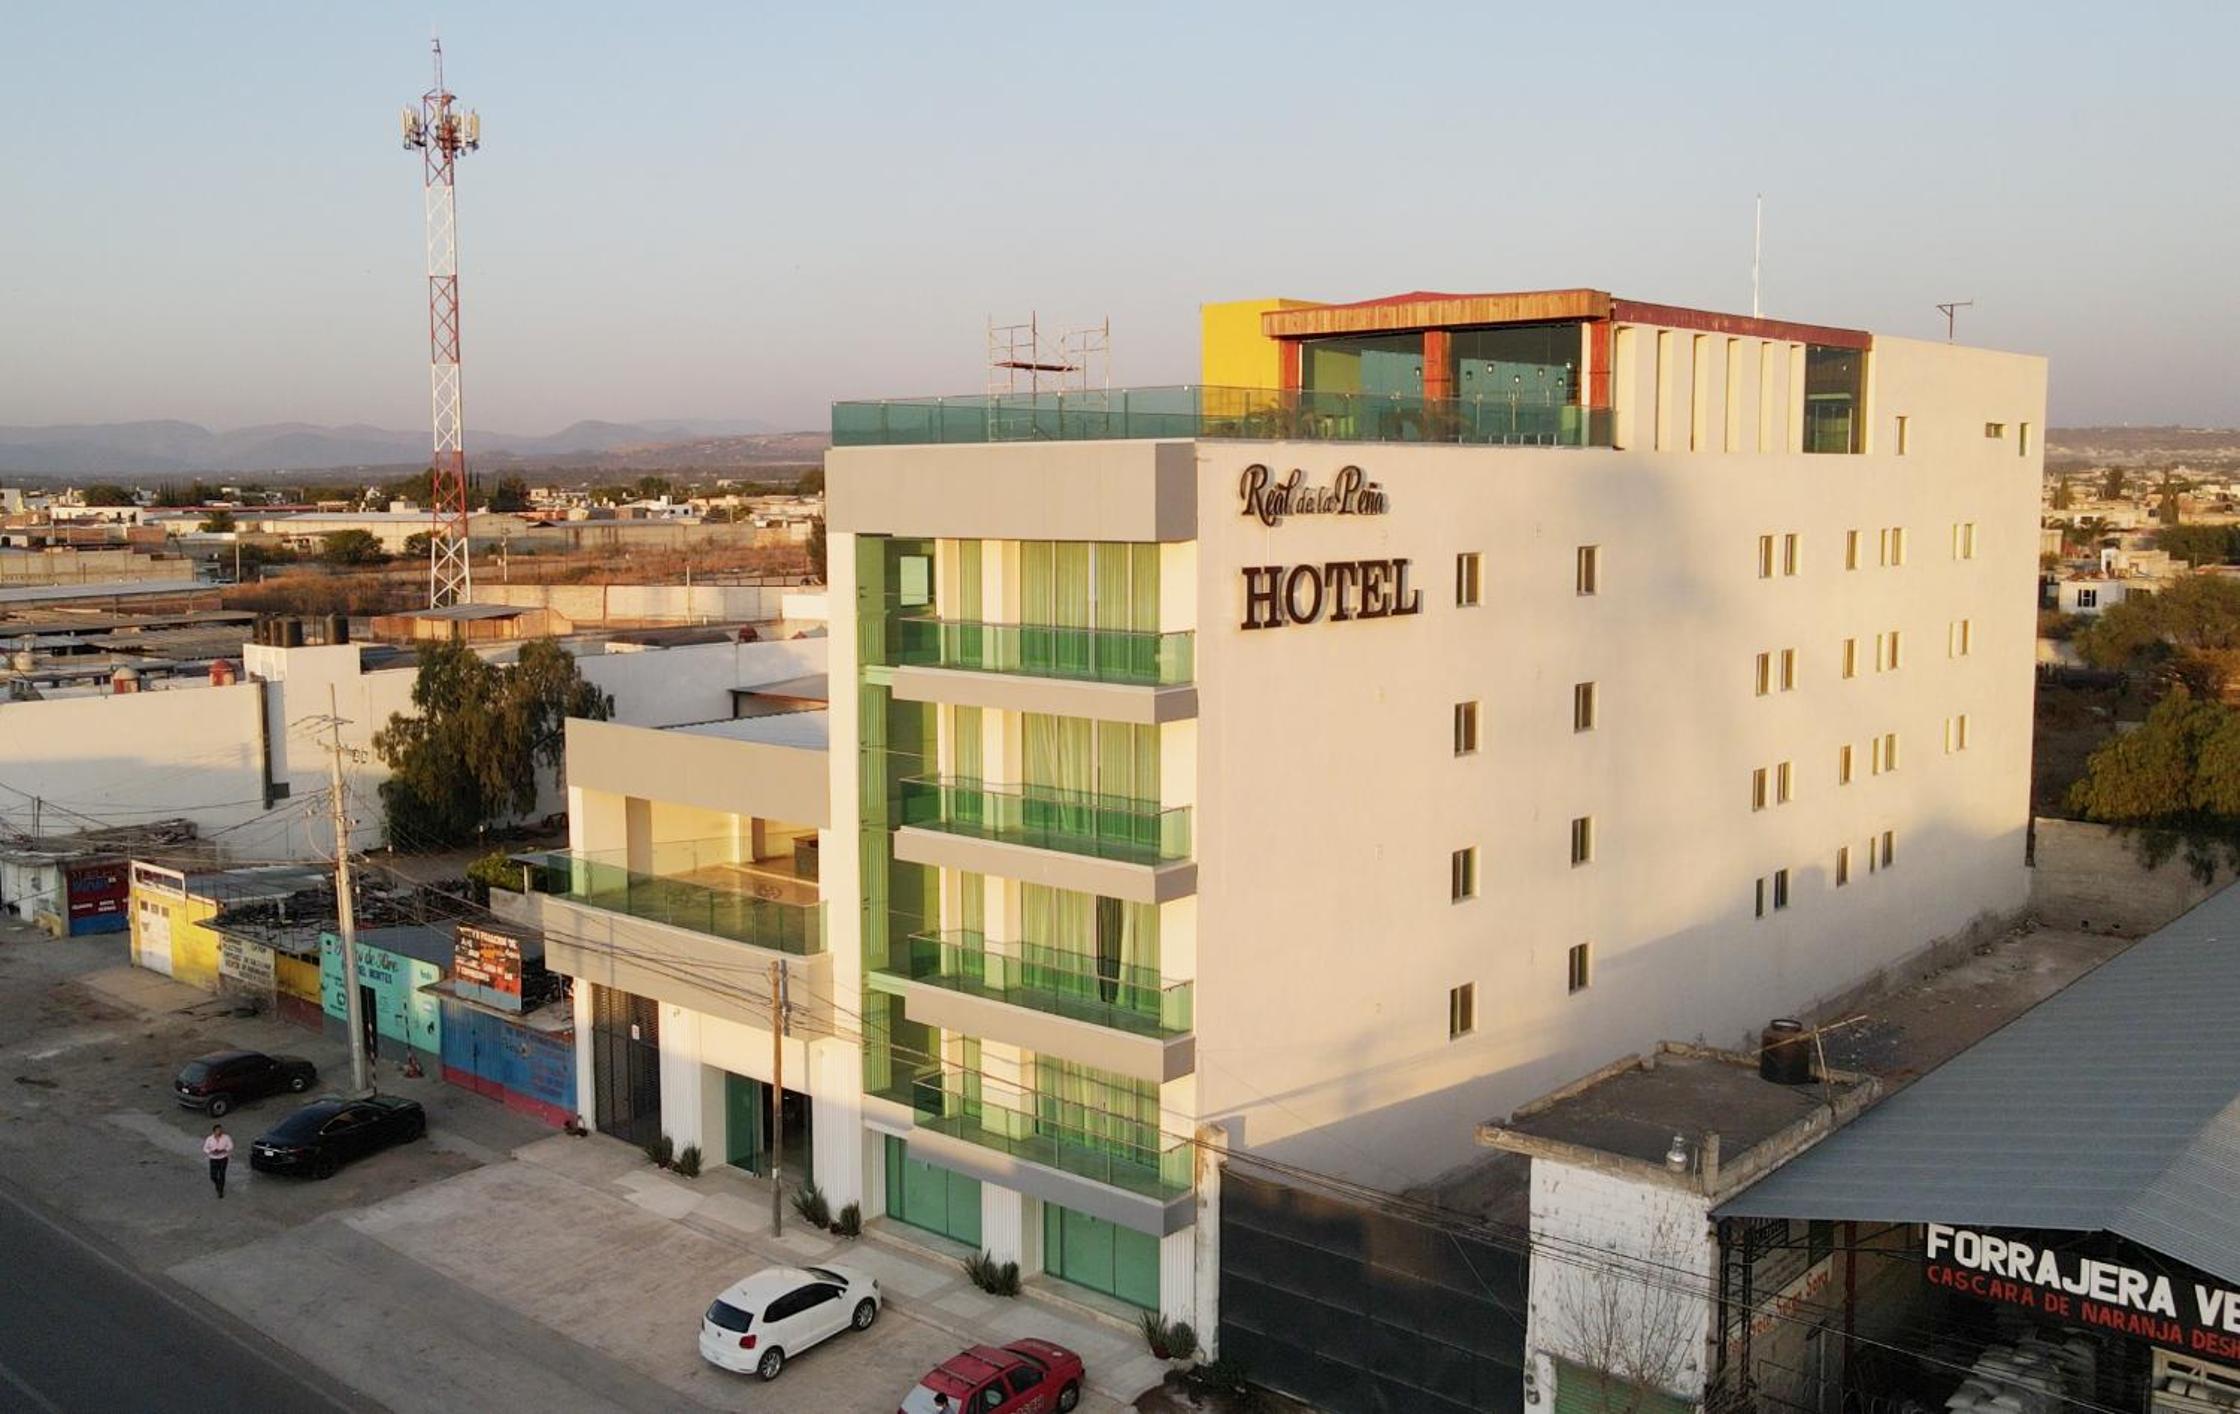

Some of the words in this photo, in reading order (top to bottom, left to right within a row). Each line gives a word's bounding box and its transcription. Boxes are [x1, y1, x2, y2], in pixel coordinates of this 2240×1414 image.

[1240, 464, 1301, 527] Real
[1296, 488, 1315, 514] de
[1318, 487, 1335, 514] la
[1335, 465, 1386, 515] Peña
[1241, 558, 1419, 630] HOTEL
[1927, 1223, 2177, 1318] FORRAJERA
[2195, 1284, 2240, 1334] VE
[1927, 1266, 2035, 1307] CASCARA
[2044, 1292, 2070, 1317] DE
[2081, 1302, 2183, 1344] NARANJA
